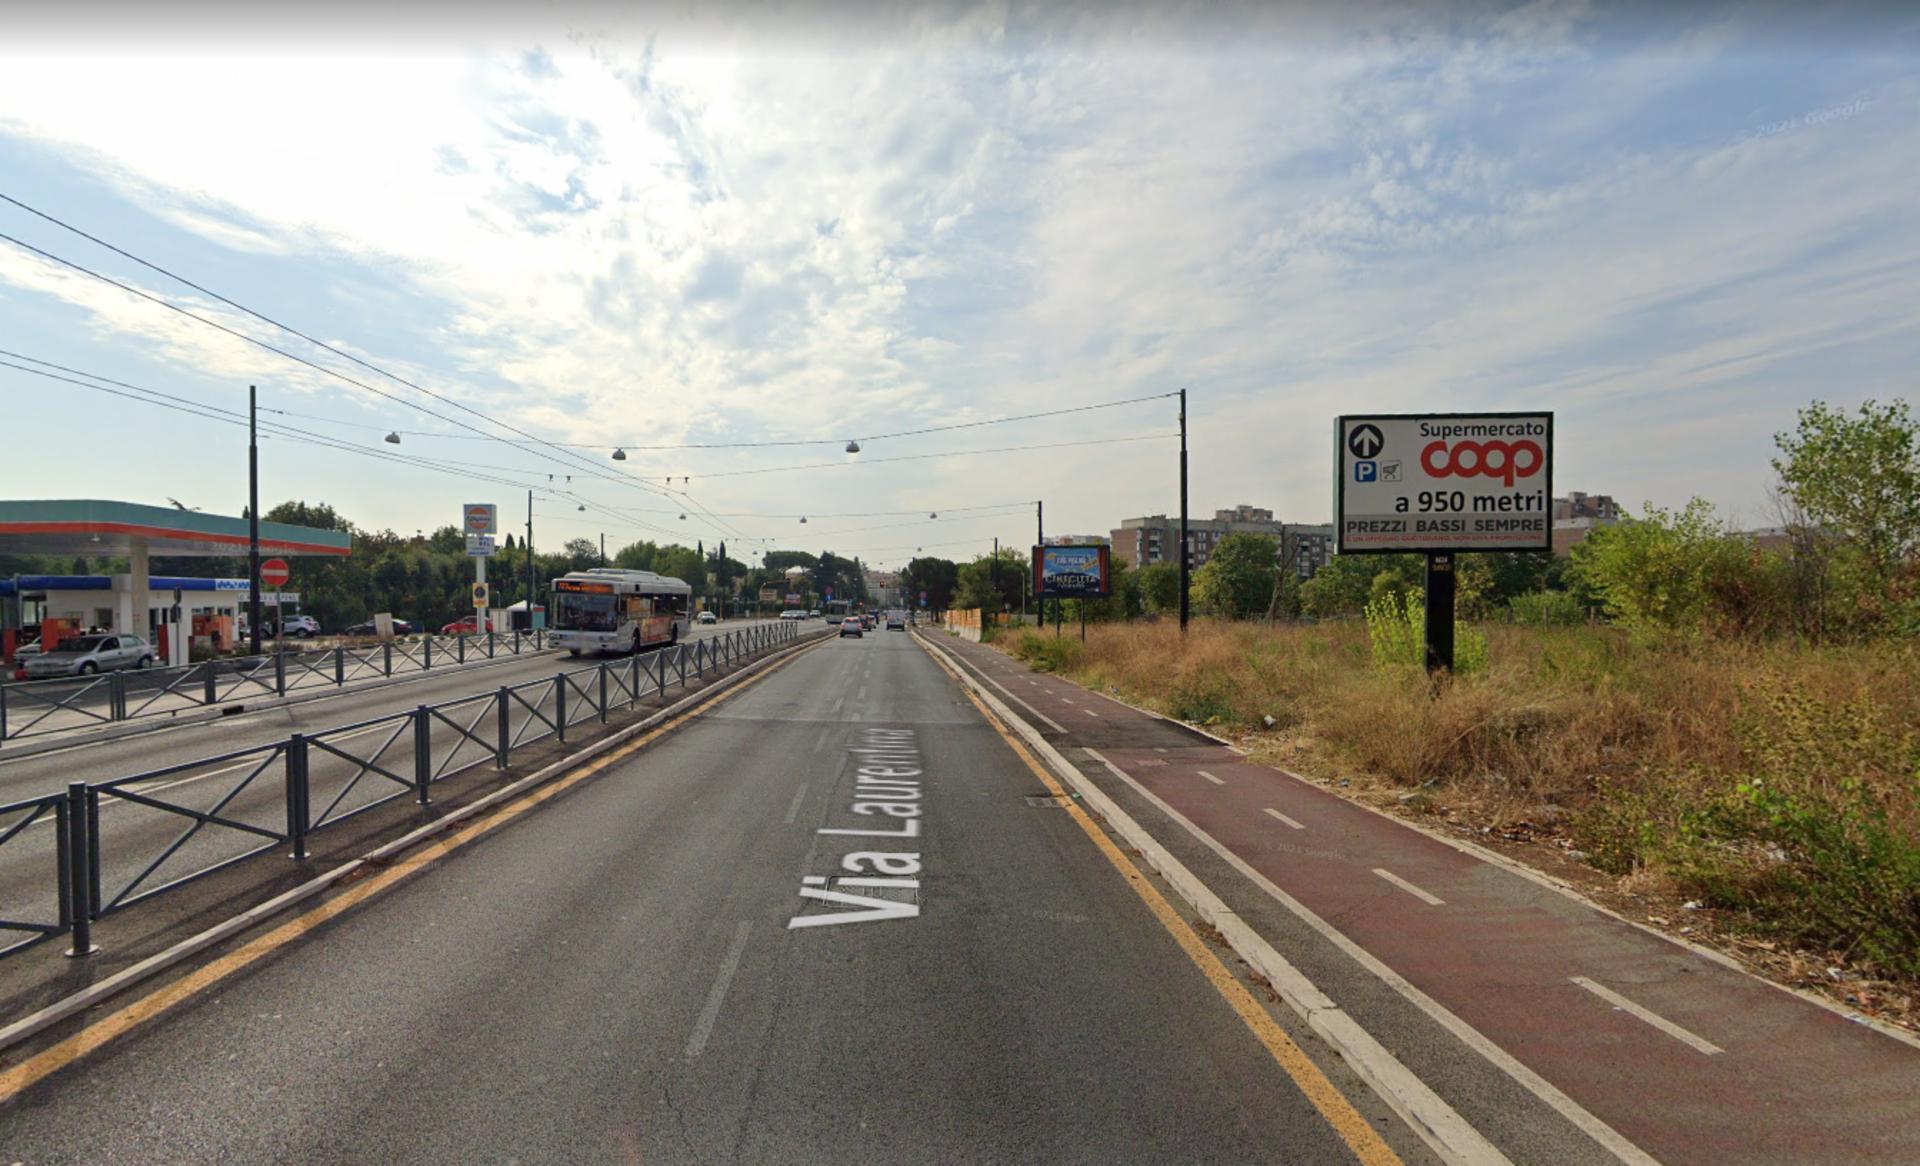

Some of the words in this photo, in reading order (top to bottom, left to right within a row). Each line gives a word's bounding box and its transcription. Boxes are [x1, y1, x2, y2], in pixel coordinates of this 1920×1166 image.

[1420, 422, 1544, 439] Supermercato
[1420, 439, 1544, 487] coop
[1359, 465, 1372, 480] P
[1395, 496, 1409, 512] a
[1418, 491, 1465, 512] 950
[1473, 490, 1543, 512] metri
[1346, 520, 1407, 532] PREZZI
[1416, 519, 1465, 532] BASSI
[1474, 519, 1544, 531] SEMPRE
